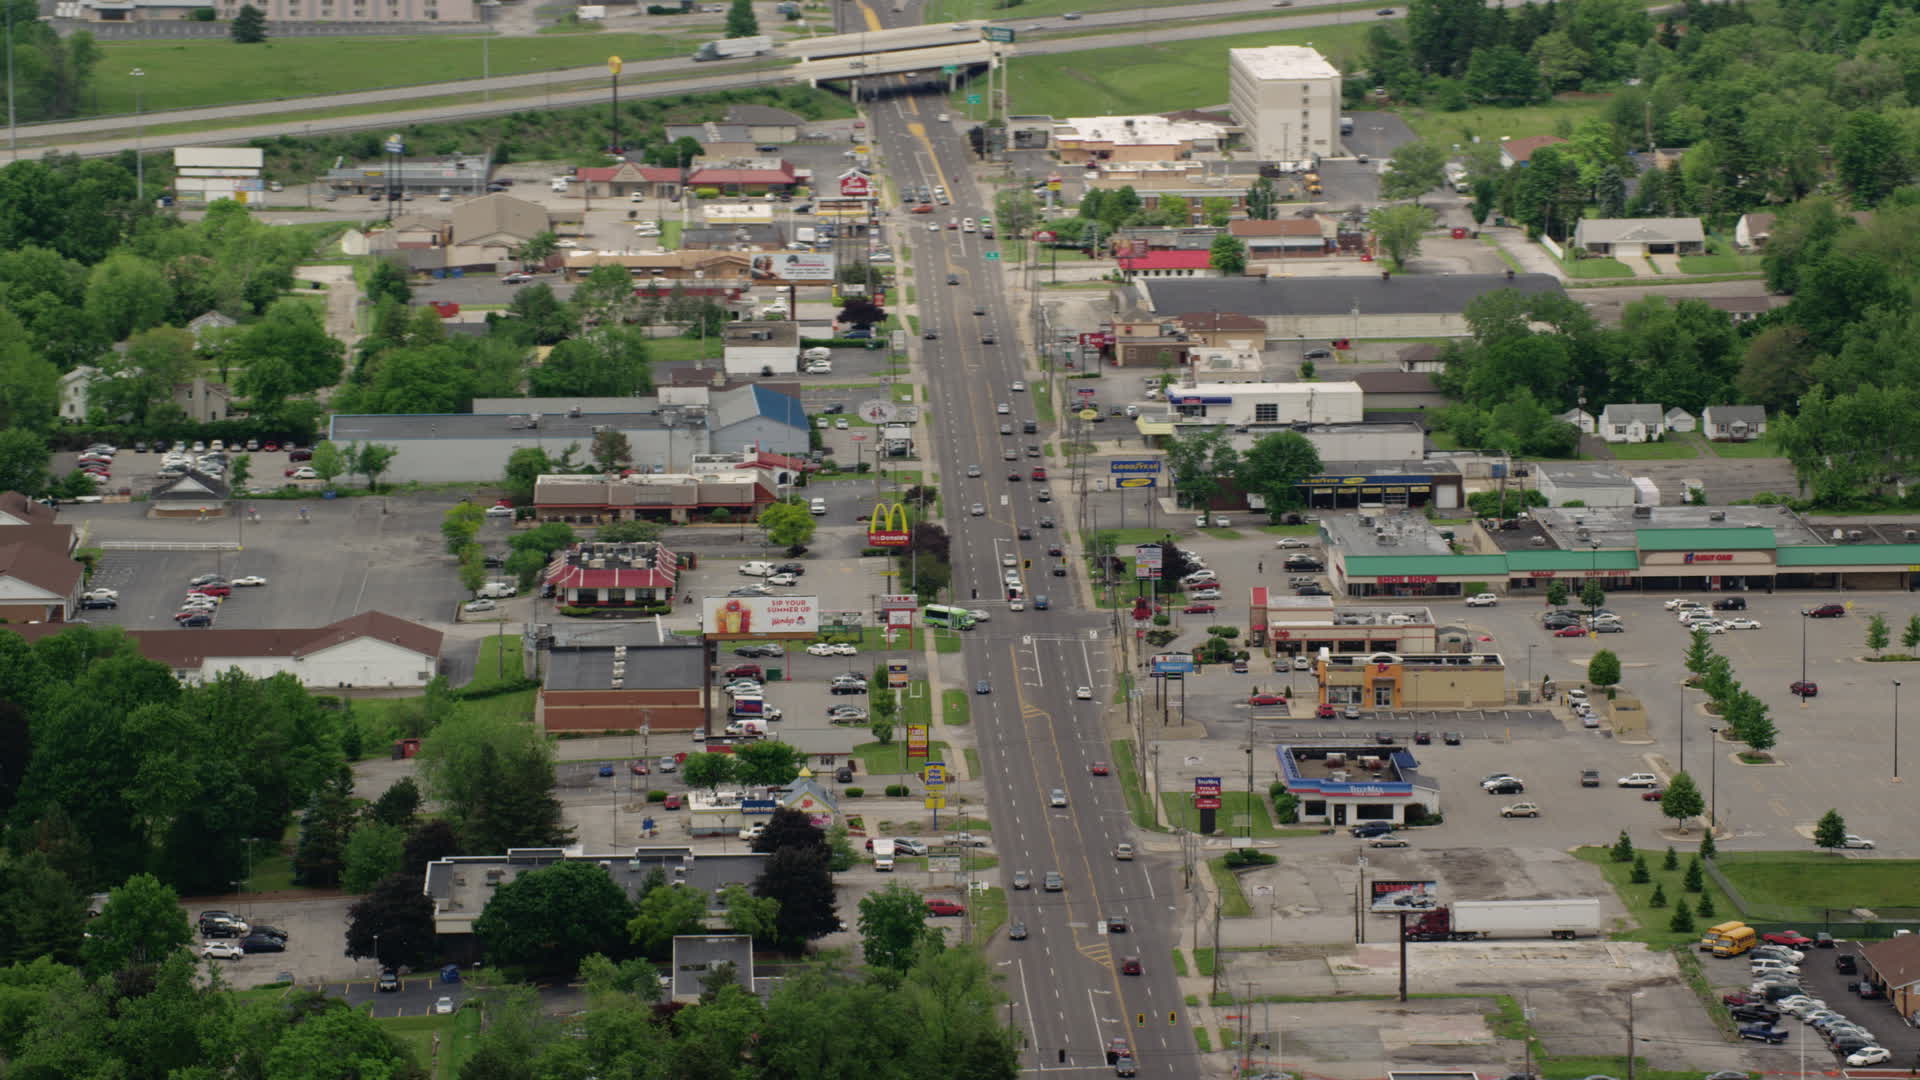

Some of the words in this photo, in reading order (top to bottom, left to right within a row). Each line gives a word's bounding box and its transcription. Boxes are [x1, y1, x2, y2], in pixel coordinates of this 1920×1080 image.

[1112, 462, 1158, 470] GOODYEAR
[1377, 576, 1405, 584] SHOE
[1408, 575, 1438, 583] SHOW
